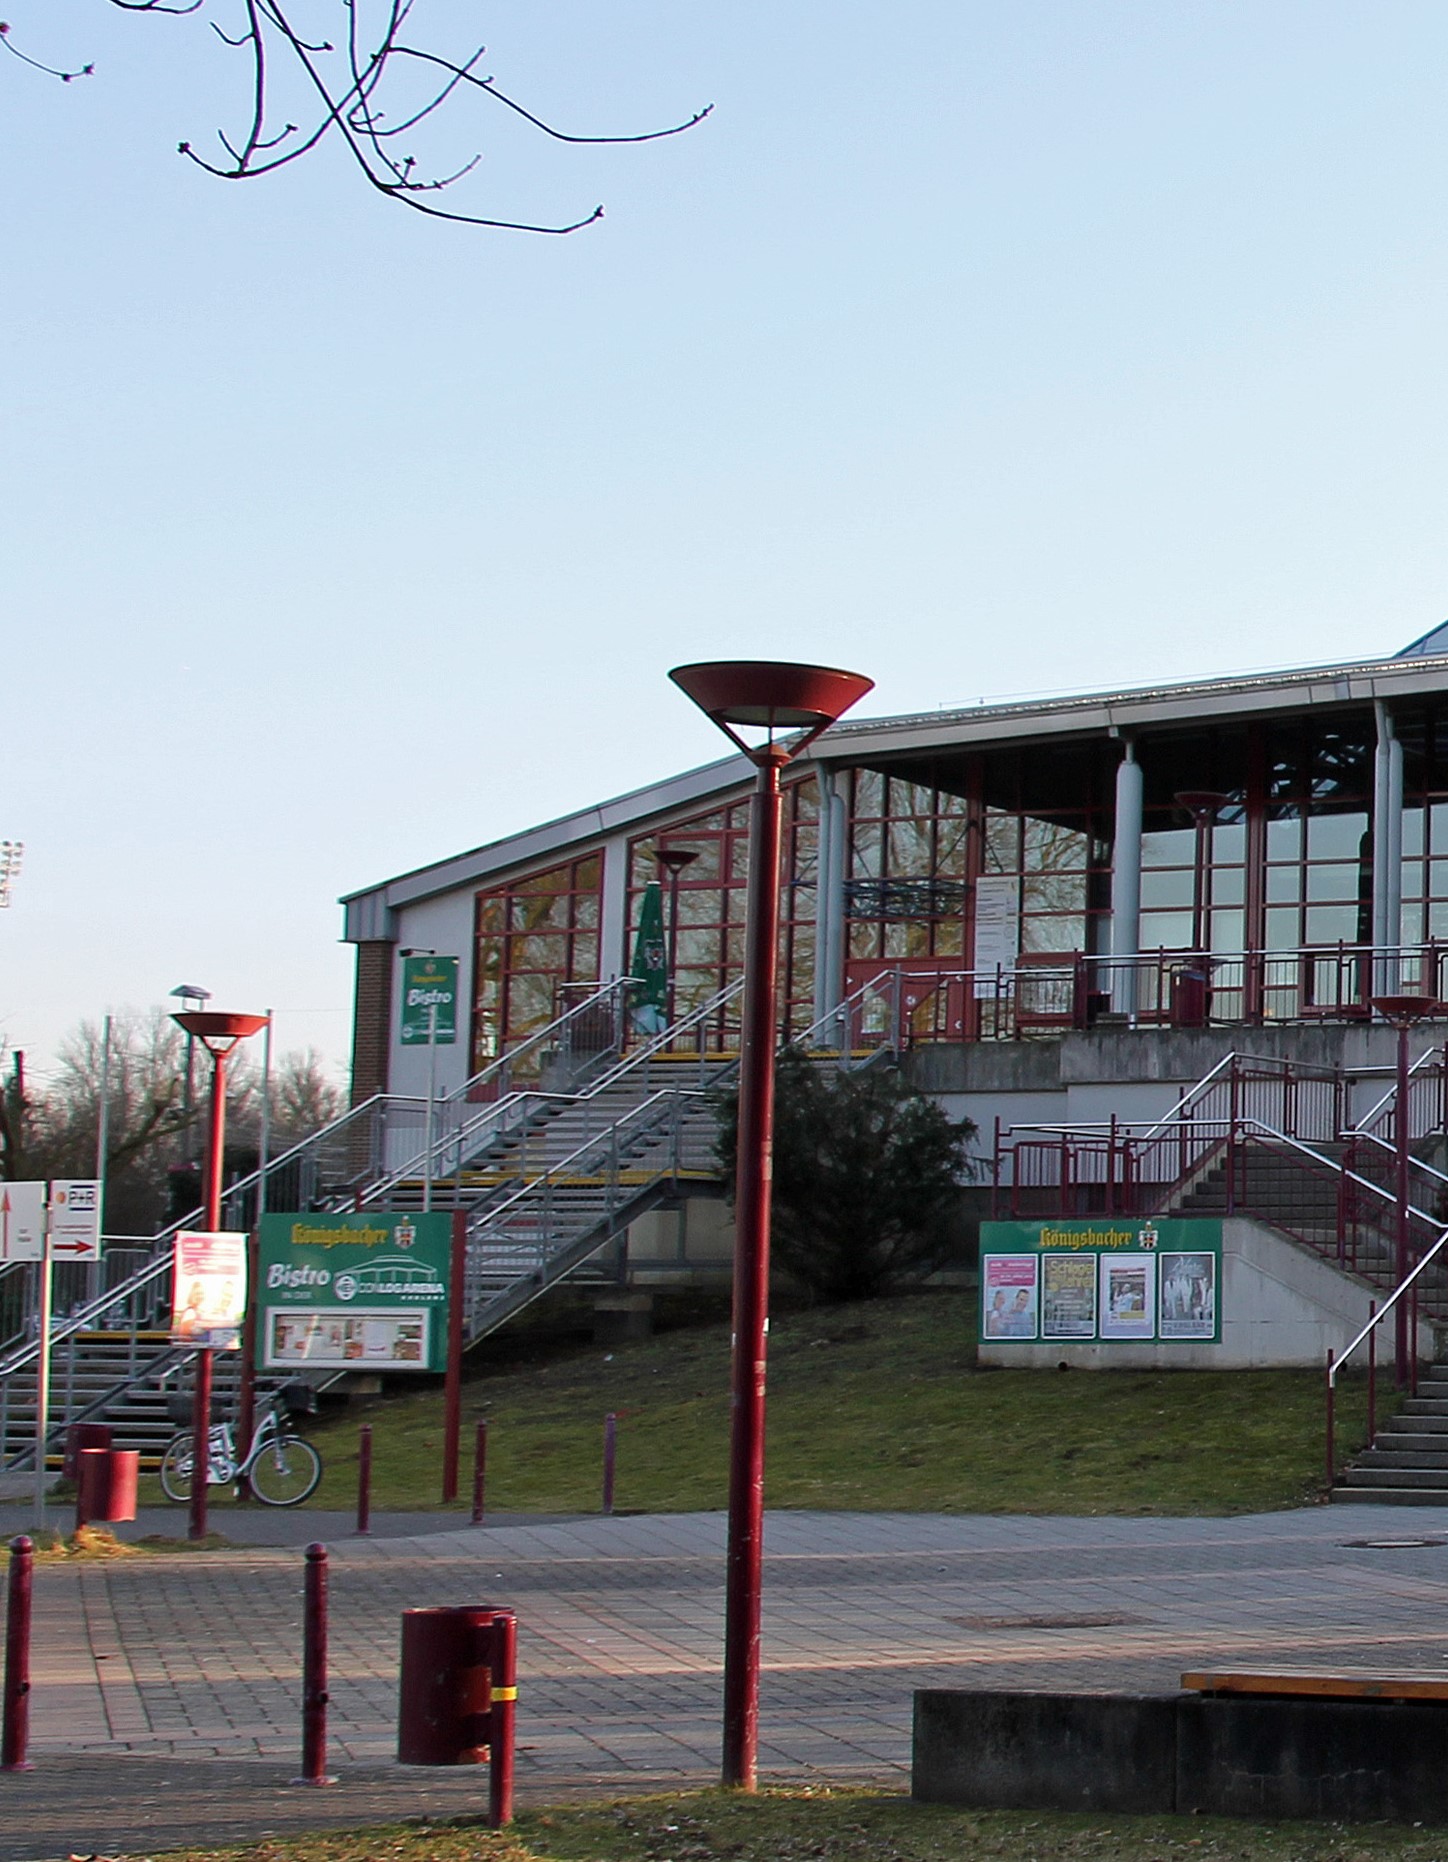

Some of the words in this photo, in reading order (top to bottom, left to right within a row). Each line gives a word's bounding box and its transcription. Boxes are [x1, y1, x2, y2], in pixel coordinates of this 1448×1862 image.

[407, 988, 452, 1006] Bistro
[1040, 1227, 1132, 1250] Königsbacher
[267, 1263, 331, 1289] Bistro
